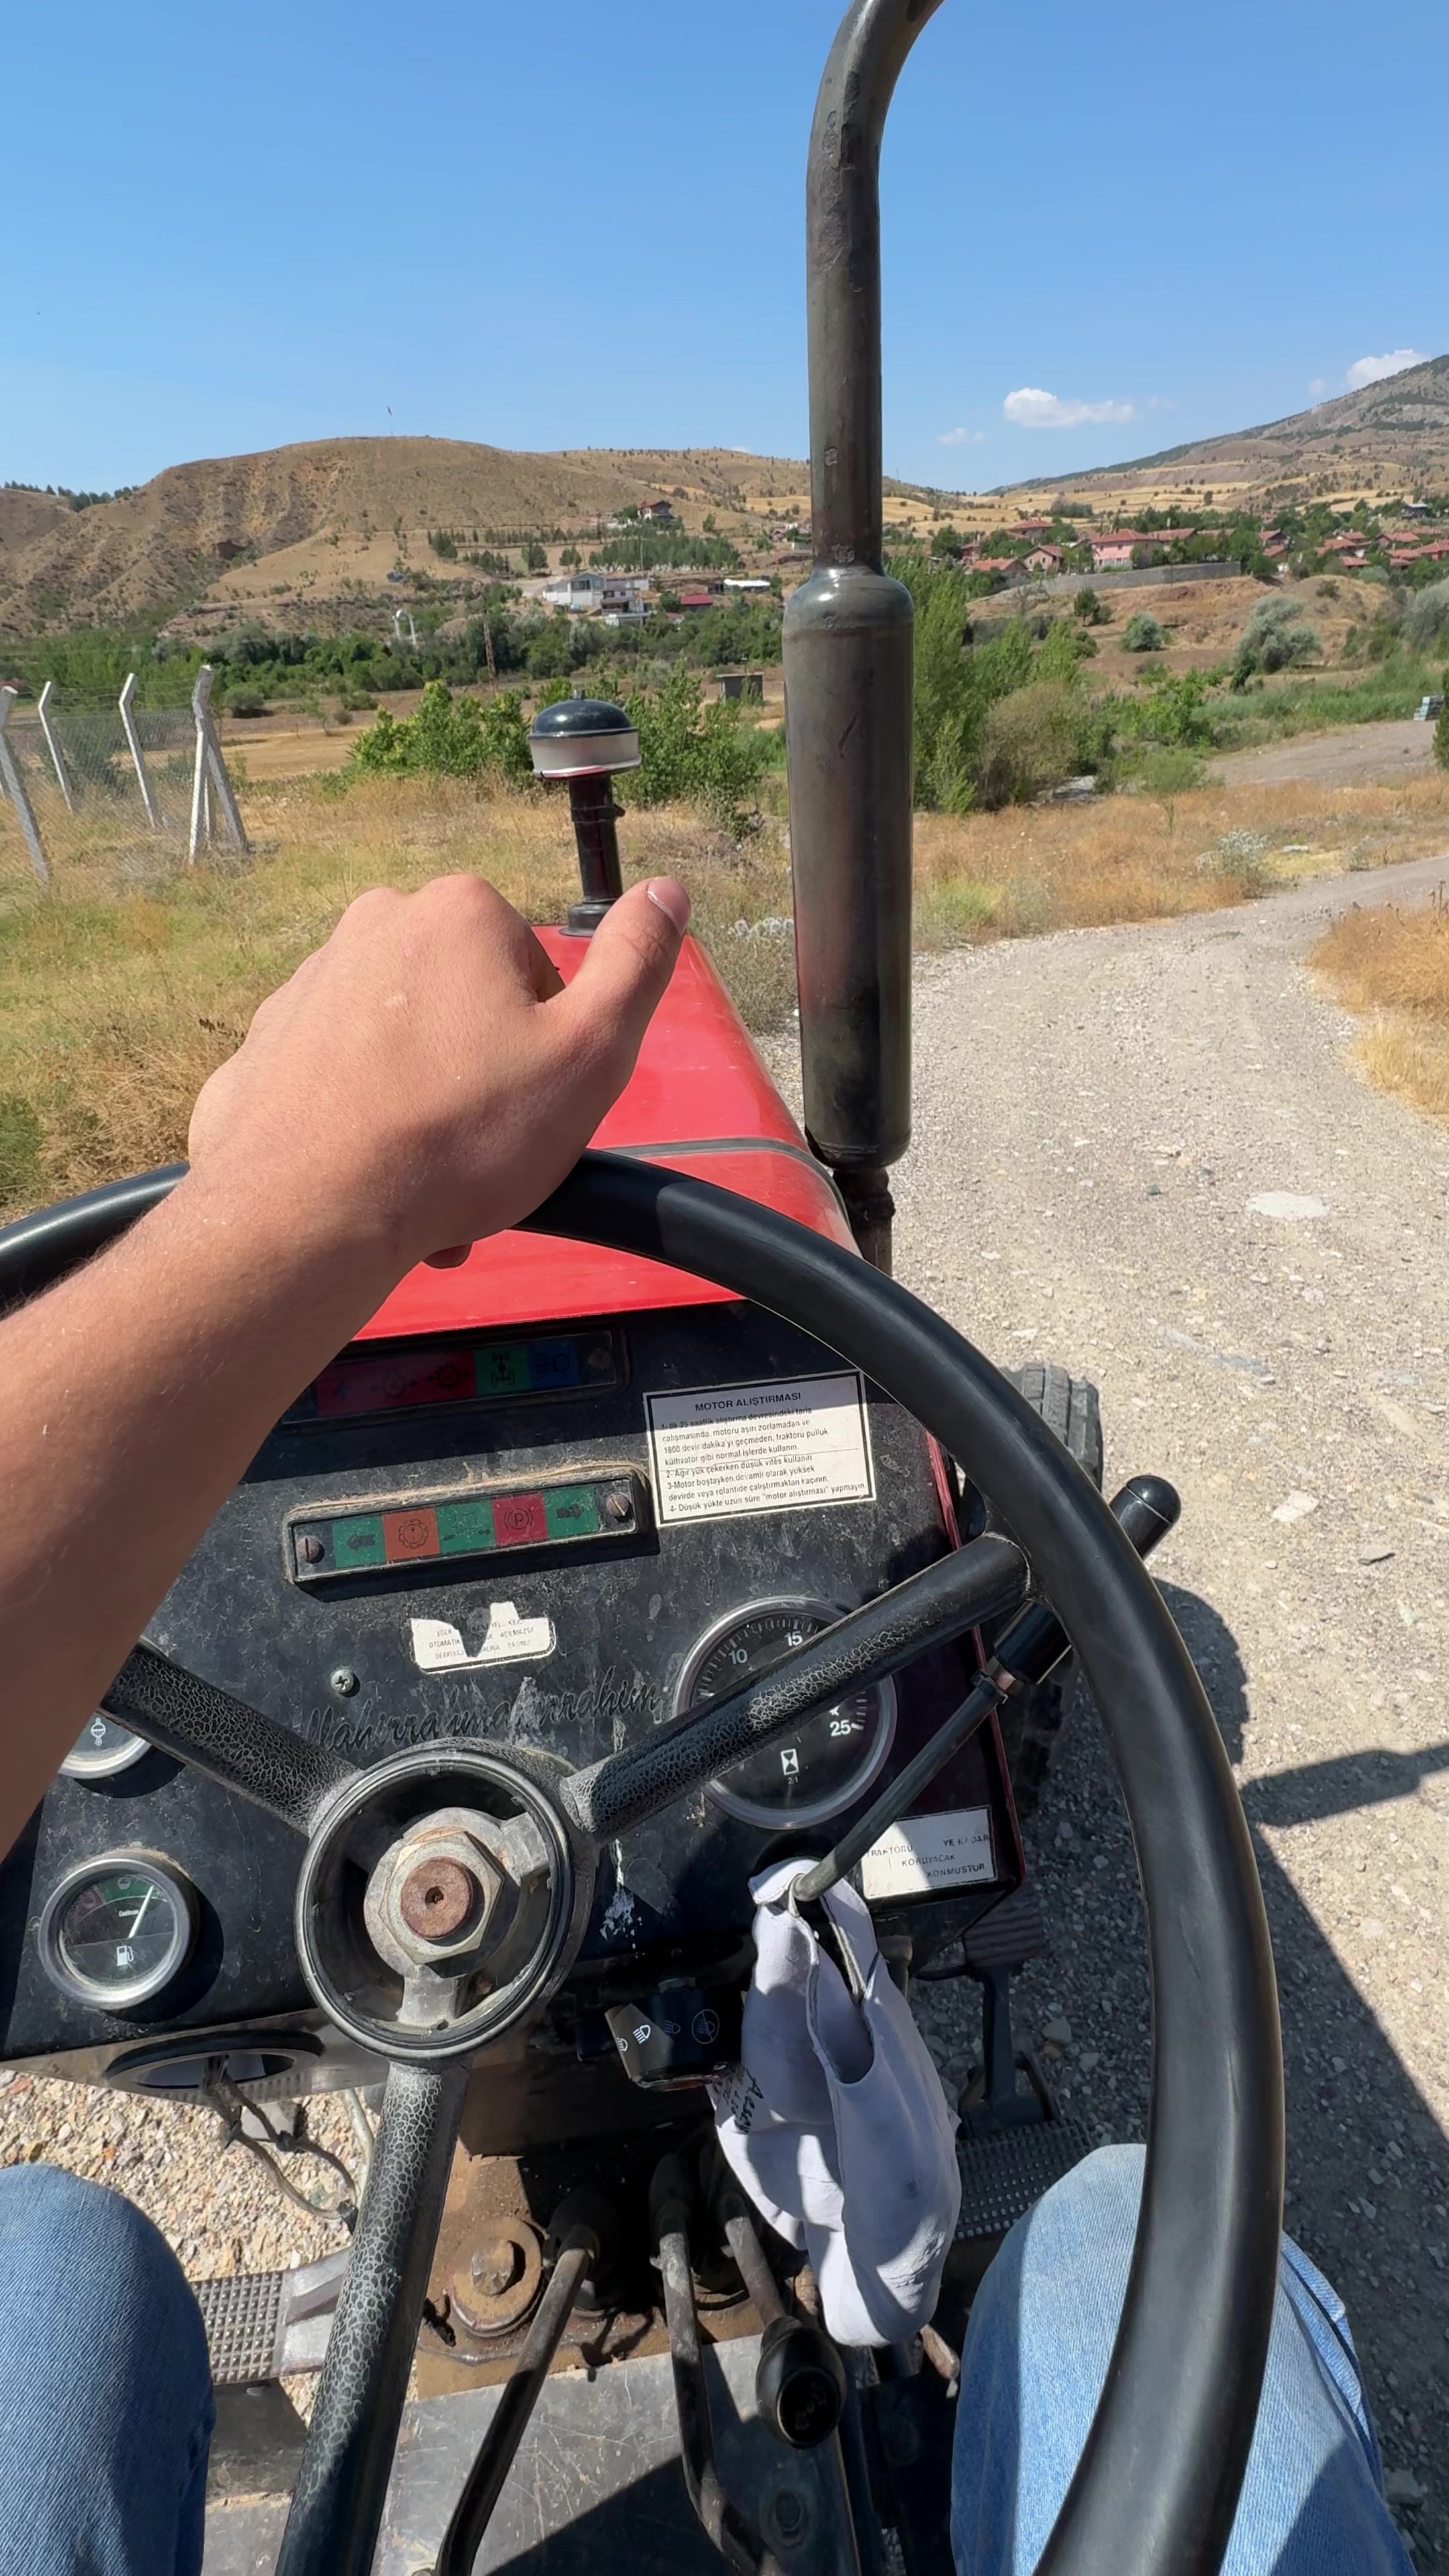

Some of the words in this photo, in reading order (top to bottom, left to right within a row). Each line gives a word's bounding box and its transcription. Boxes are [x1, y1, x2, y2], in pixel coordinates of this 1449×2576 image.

[695, 1400, 733, 1411] MOTOR
[736, 1392, 801, 1407] ALIŞTIRMASI
[796, 1405, 811, 1413] tarla
[758, 1419, 800, 1431] zorlamadan
[664, 1444, 680, 1454] 1800
[682, 1442, 700, 1451] devir
[806, 1427, 828, 1438] pulluk
[700, 1453, 714, 1463] gibi
[715, 1450, 741, 1459] normal
[765, 1468, 788, 1477] olarak
[668, 1491, 695, 1501] devirde
[697, 1489, 714, 1499] veya
[724, 1497, 742, 1505] uzun
[784, 1630, 803, 1647] 15
[729, 1648, 748, 1664] 10
[829, 1719, 852, 1737] 25
[902, 1854, 956, 1867] KORUYACAK
